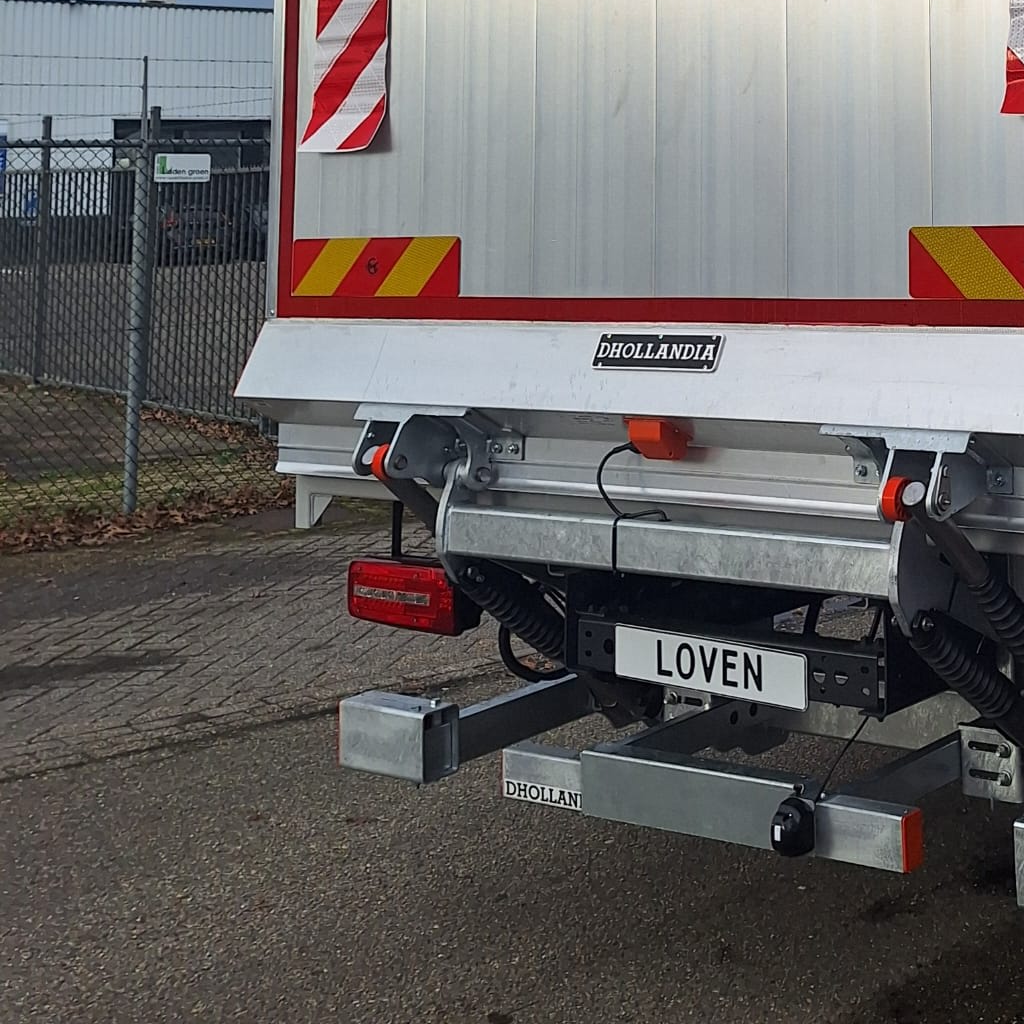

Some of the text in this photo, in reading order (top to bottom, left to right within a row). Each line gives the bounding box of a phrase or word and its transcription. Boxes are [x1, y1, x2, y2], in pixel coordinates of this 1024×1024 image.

[596, 342, 716, 361] DHOLLANDIA
[656, 639, 763, 692] LOVEN
[505, 780, 583, 809] DHOLLAN
